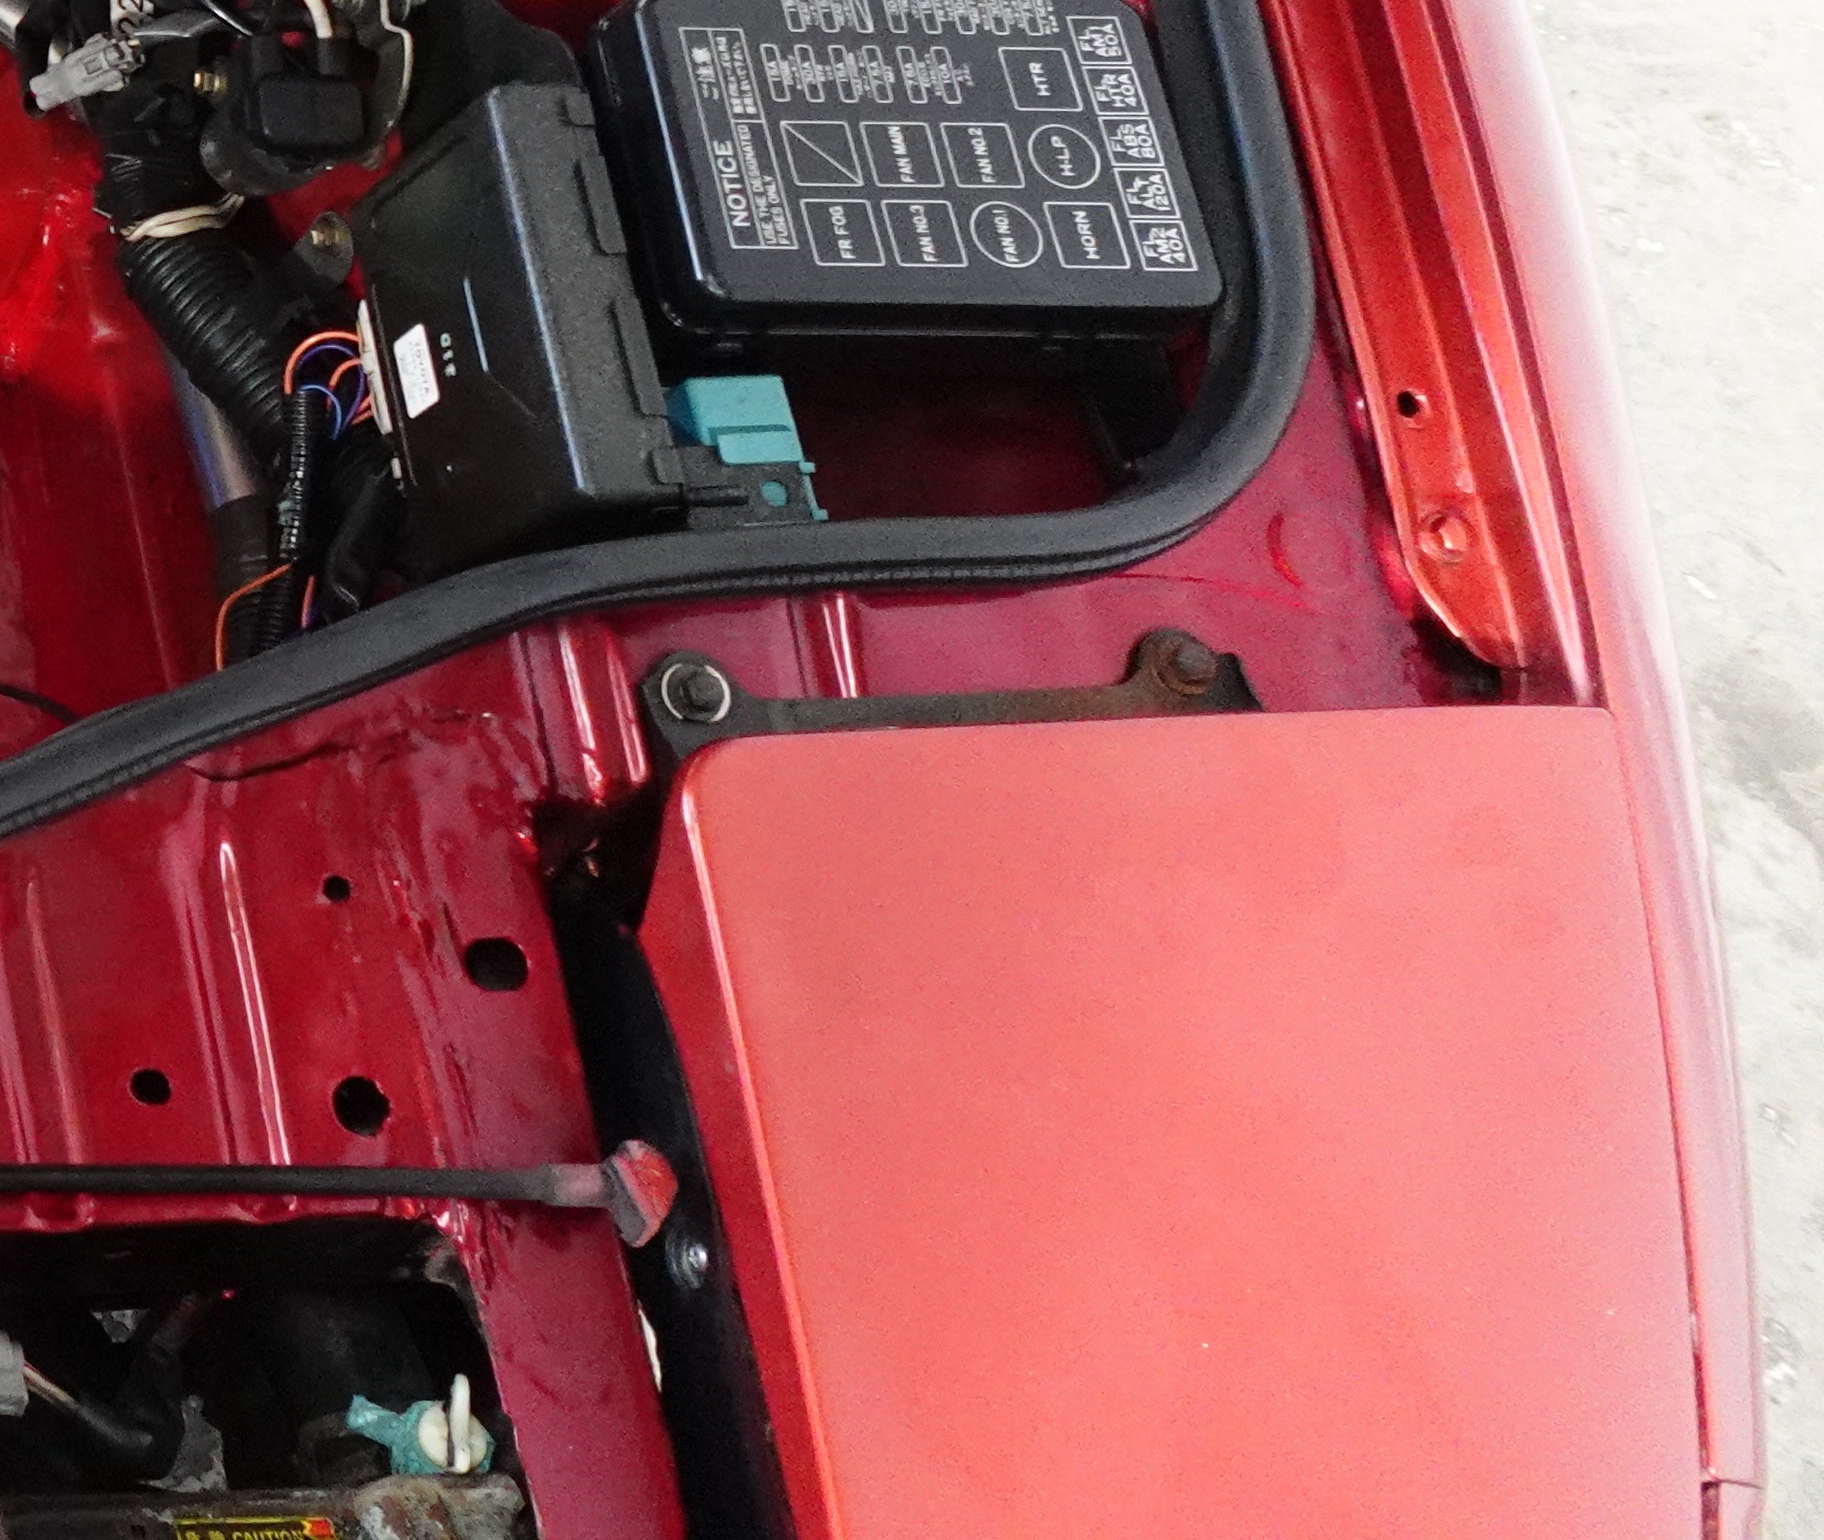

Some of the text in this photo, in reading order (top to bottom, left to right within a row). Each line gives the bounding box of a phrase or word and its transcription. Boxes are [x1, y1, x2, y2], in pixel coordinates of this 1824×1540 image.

[1080, 30, 1094, 52] FL
[1104, 23, 1122, 56] 50A
[1029, 62, 1051, 96] HTR
[1094, 81, 1110, 102] FL
[1103, 74, 1124, 107] HTR
[1119, 74, 1138, 106] 40A
[888, 126, 915, 183] FAN MAIN
[969, 127, 997, 183] FAN NO.2
[1050, 134, 1075, 176] H-LP
[1112, 130, 1126, 152] FL
[1122, 124, 1142, 158] ABS
[1135, 124, 1156, 158] 80A
[714, 140, 751, 227] NOTICE
[738, 124, 777, 244] USE THE DESIGNATED
[1126, 186, 1141, 205] FL
[1133, 177, 1155, 209] ALT
[1150, 174, 1172, 212] 120A
[763, 176, 791, 244] FUSES ONLY
[828, 205, 857, 259] FR FOG
[910, 204, 939, 262] FAN NO.3
[992, 208, 1020, 262] FAN NO.1
[1072, 210, 1100, 260] HORN
[1142, 238, 1156, 258] FL
[1151, 228, 1174, 264] AM2
[1168, 227, 1186, 263] 40A
